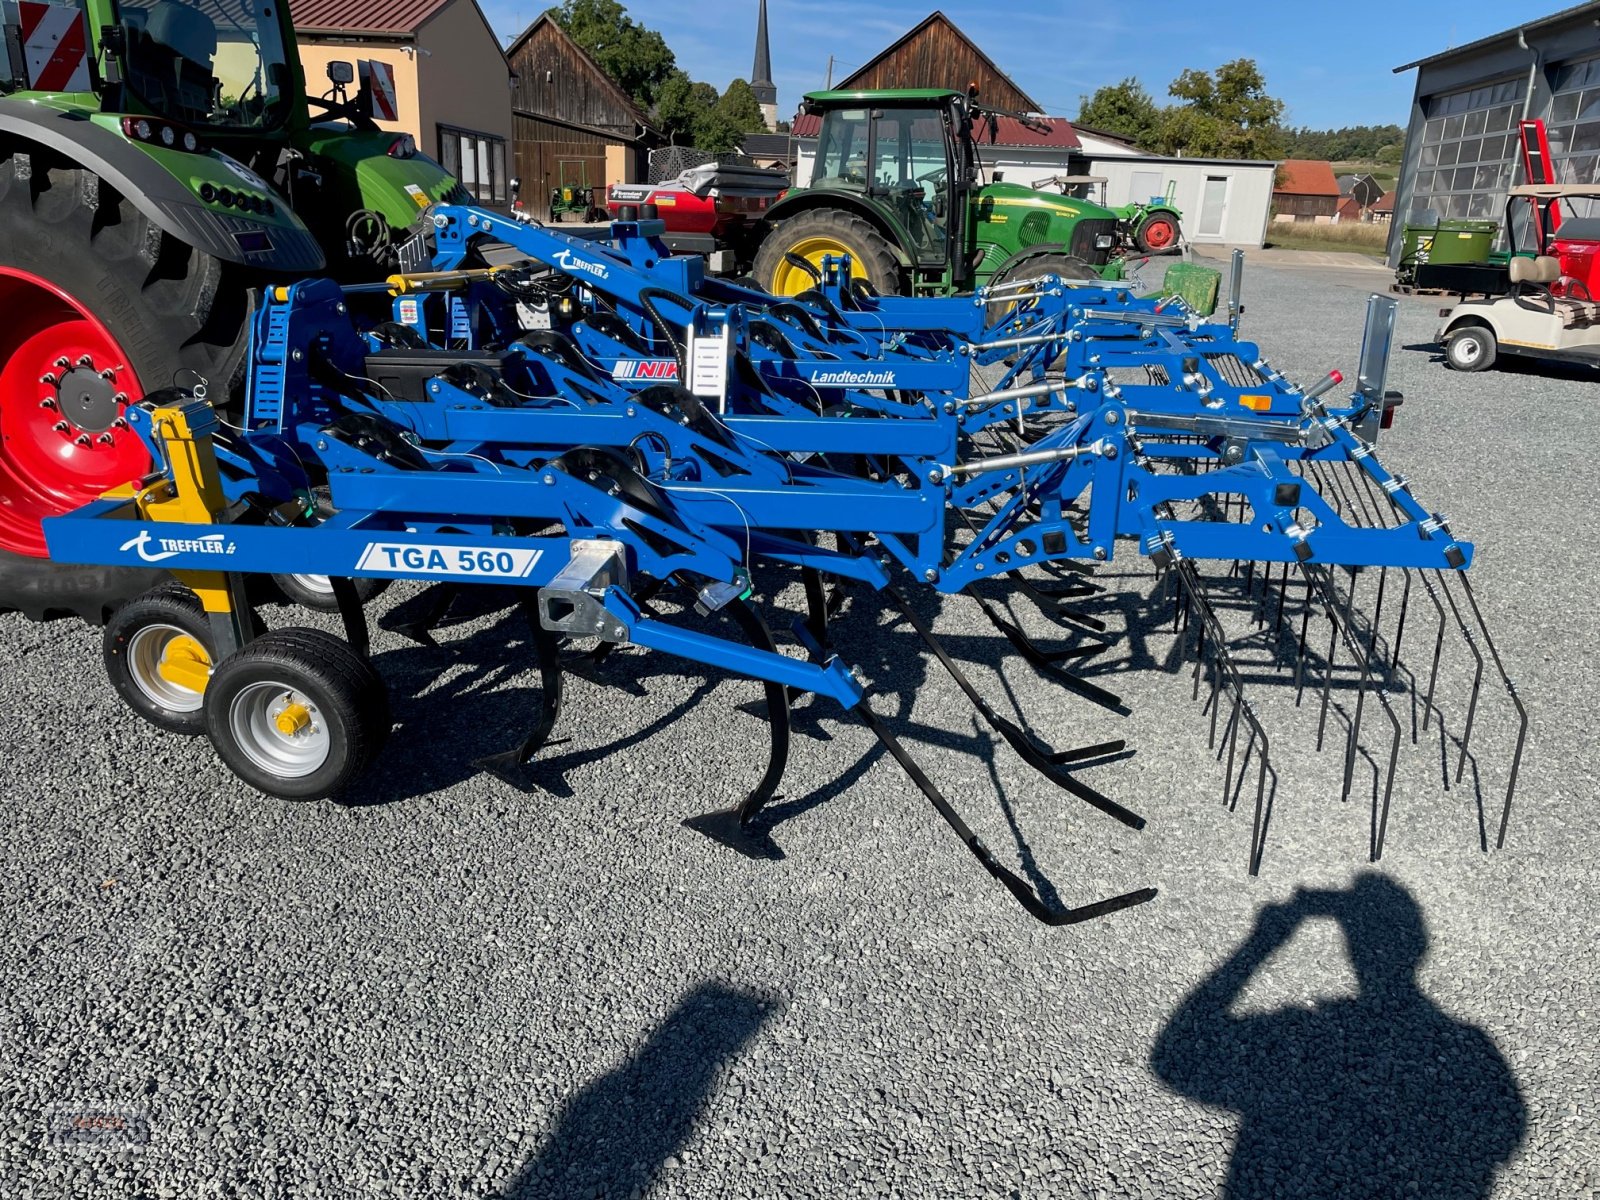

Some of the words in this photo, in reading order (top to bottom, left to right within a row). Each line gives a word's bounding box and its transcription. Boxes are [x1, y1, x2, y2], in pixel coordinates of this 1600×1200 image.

[573, 256, 604, 278] TREFFLER
[635, 361, 679, 379] NIK
[811, 370, 896, 384] Landtechnik
[158, 538, 225, 555] TREFFLER
[381, 546, 449, 571] TGA
[457, 550, 515, 574] 560
